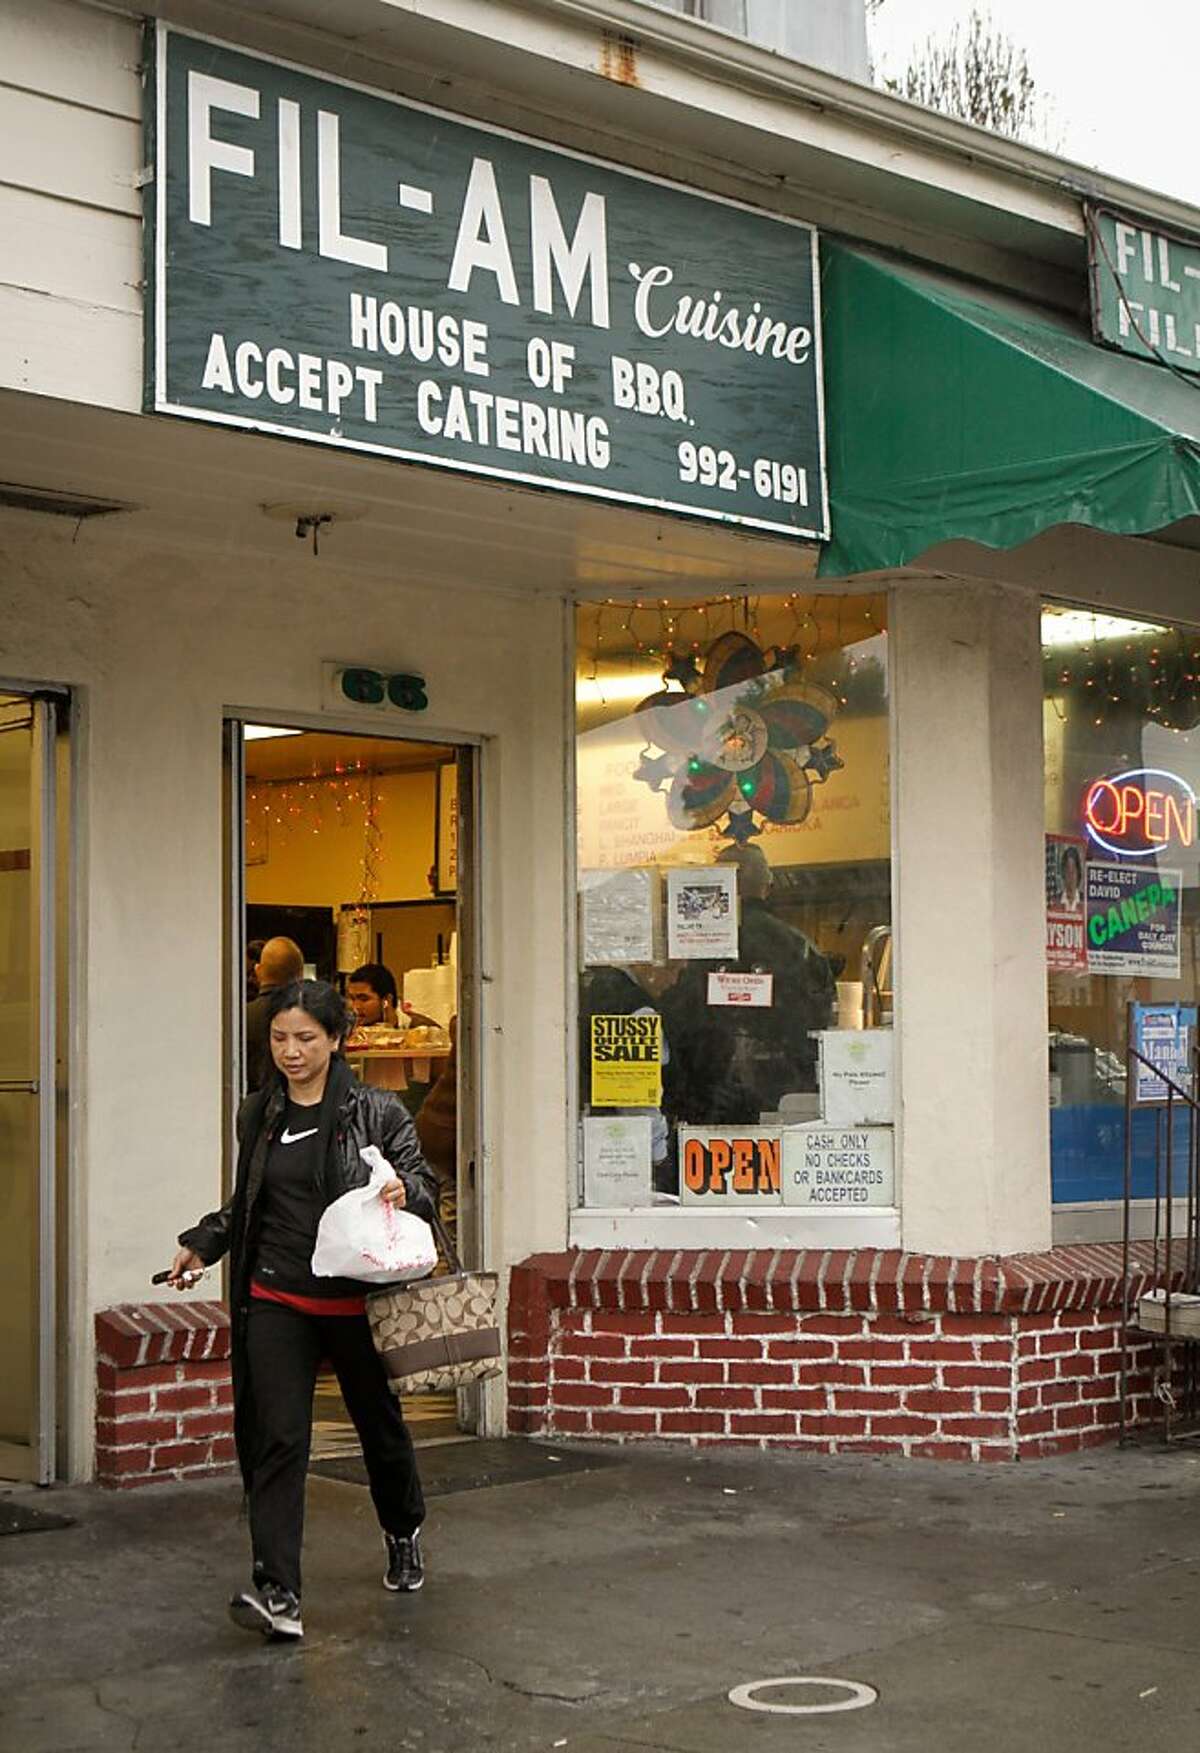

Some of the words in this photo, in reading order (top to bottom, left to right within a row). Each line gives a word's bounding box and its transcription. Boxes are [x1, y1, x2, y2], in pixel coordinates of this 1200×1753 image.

[188, 70, 610, 329] FIL-AM
[628, 261, 812, 365] Cuisine
[350, 293, 489, 377] HOUSE
[527, 337, 575, 394] OF
[612, 356, 696, 426] B.B.Q.
[202, 334, 383, 422] ACCEPT
[417, 380, 610, 469] CATERING
[678, 441, 808, 507] 992-6191
[341, 668, 428, 711] 66
[1086, 780, 1193, 847] OPEN
[1090, 869, 1137, 885] RE-ELECT
[1089, 885, 1120, 898] DAVID
[1089, 876, 1176, 946] CANEPA
[594, 1017, 657, 1036] STUSSY
[594, 1046, 658, 1061] SALE
[807, 1134, 834, 1149] CASH
[841, 1134, 869, 1149] ONLY
[685, 1139, 780, 1194] OPEN
[805, 1153, 821, 1167] NO
[827, 1153, 871, 1168] CHECKS
[794, 1170, 810, 1185] OR
[816, 1170, 884, 1185] BANKCARDS
[809, 1187, 869, 1202] ACCEPTED
